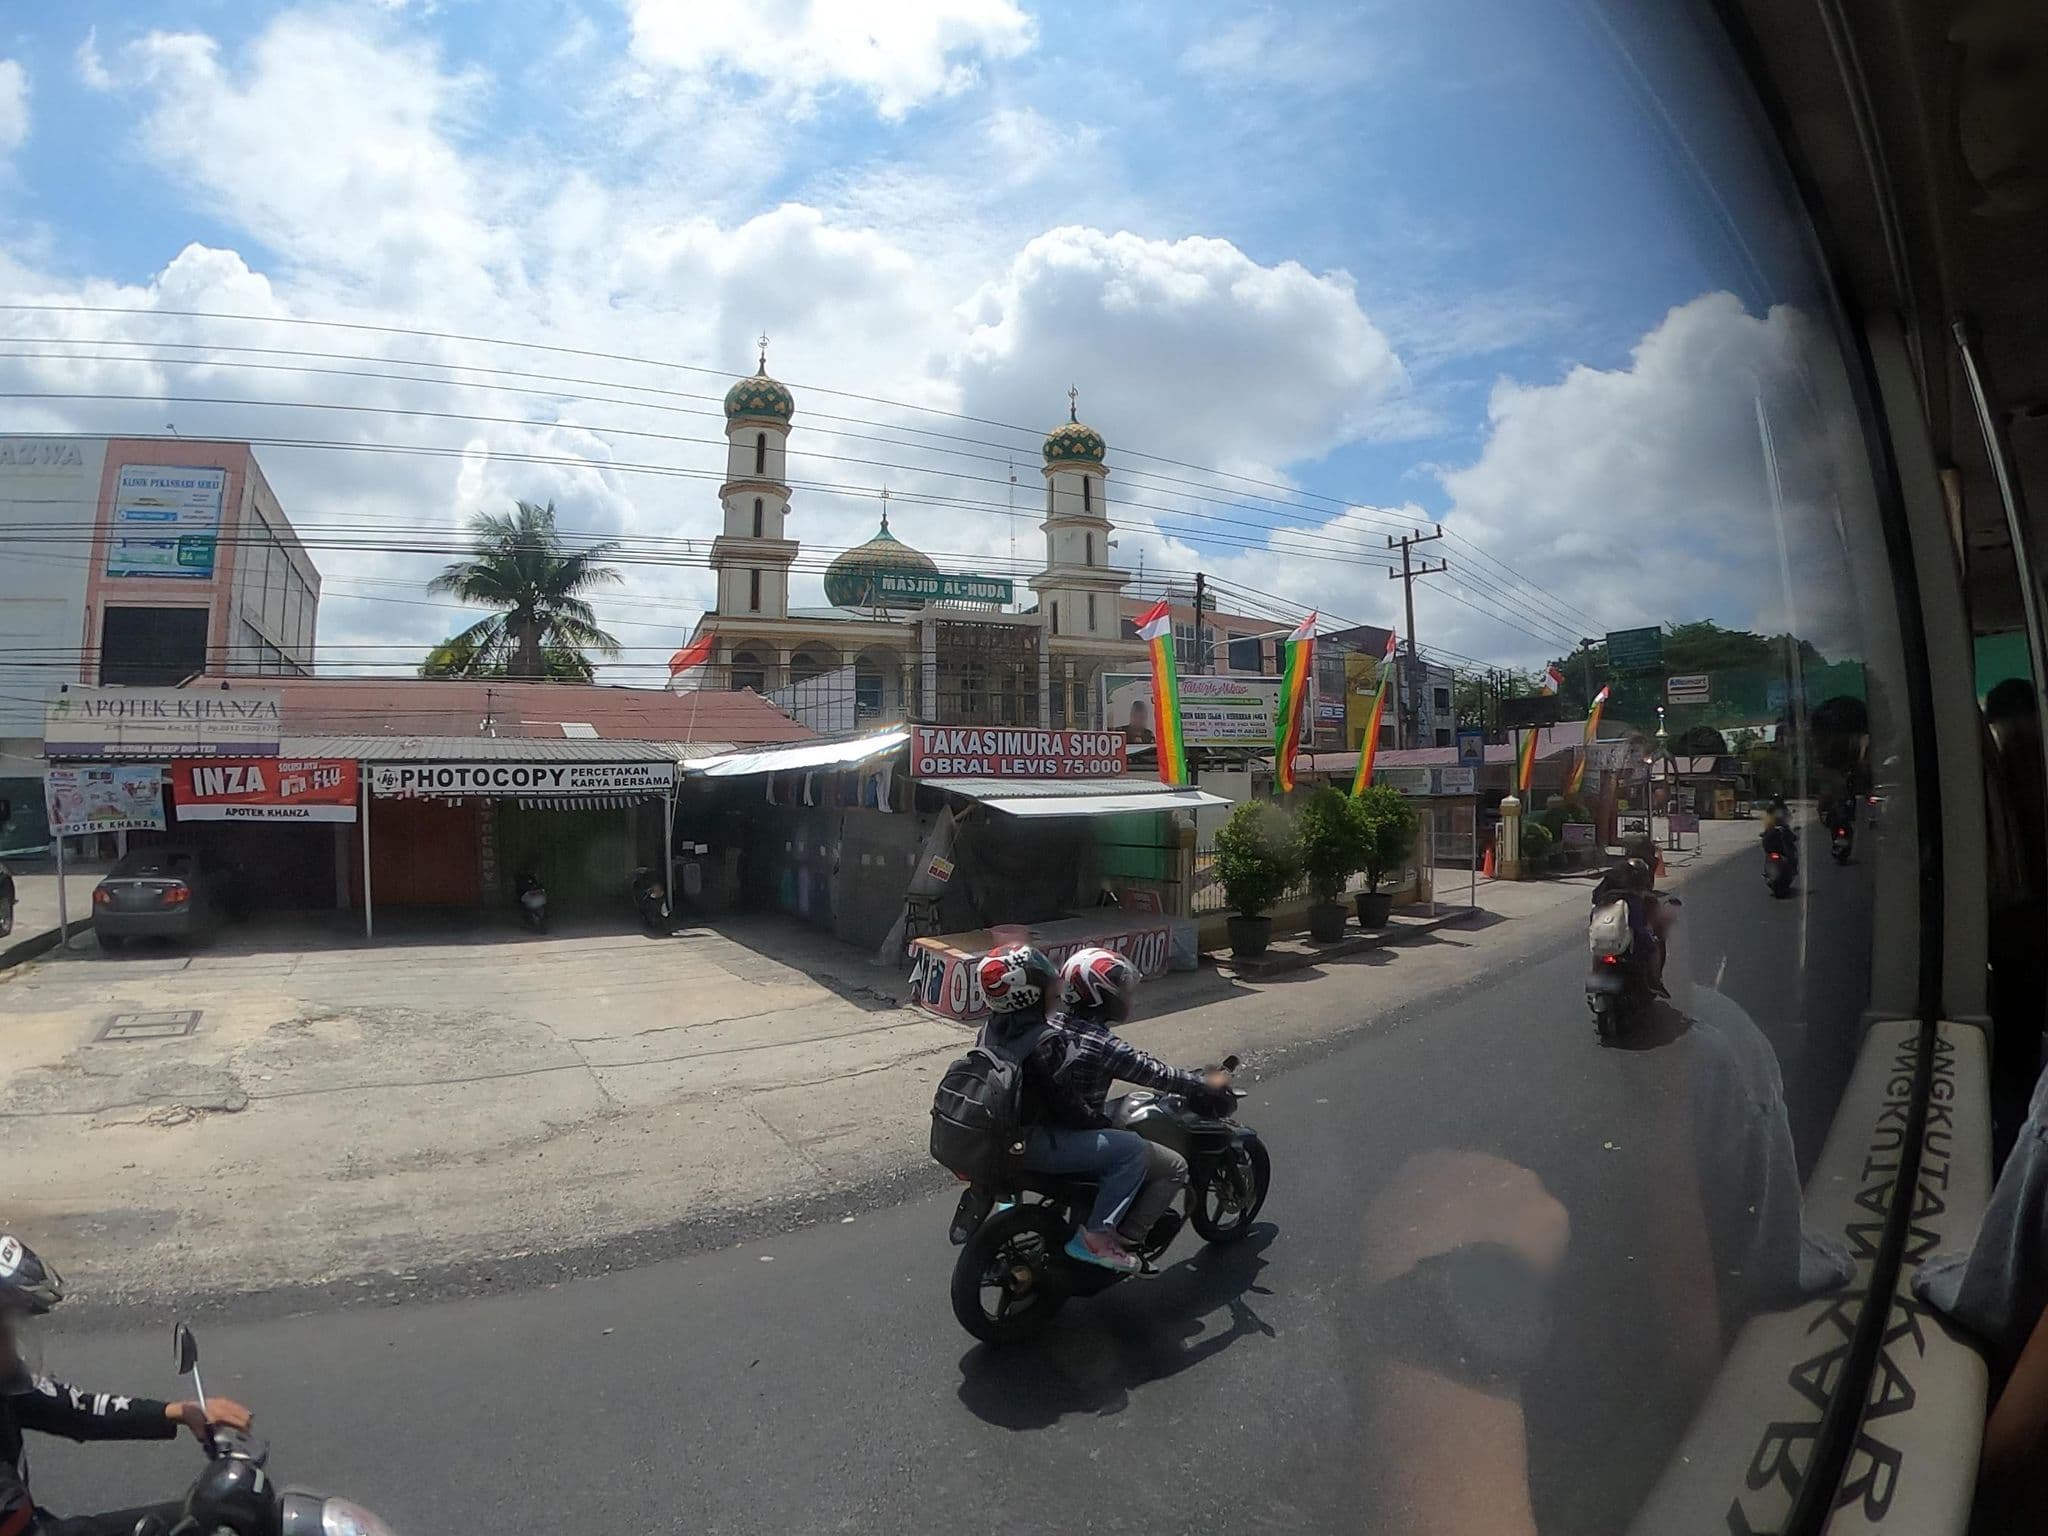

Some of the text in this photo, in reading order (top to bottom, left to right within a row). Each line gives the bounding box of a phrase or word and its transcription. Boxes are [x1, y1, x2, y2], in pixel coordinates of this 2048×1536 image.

[882, 576, 1006, 599] MASJID AL-HUDA
[79, 699, 280, 718] APOTEK KHANZA
[919, 729, 1123, 757] TAKASIMURA SHOP
[571, 767, 649, 777] PERCETAKAN
[919, 758, 1122, 775] OBRAL LEVIS 75.000
[192, 766, 267, 797] INZA
[400, 768, 565, 788] PHOTOCOPY
[571, 777, 671, 788] KARYA BERSAMA
[225, 807, 310, 818] APOTEK KHANZA
[110, 820, 156, 829] KHANZA
[1903, 1035, 1955, 1265] ANGKUTAN
